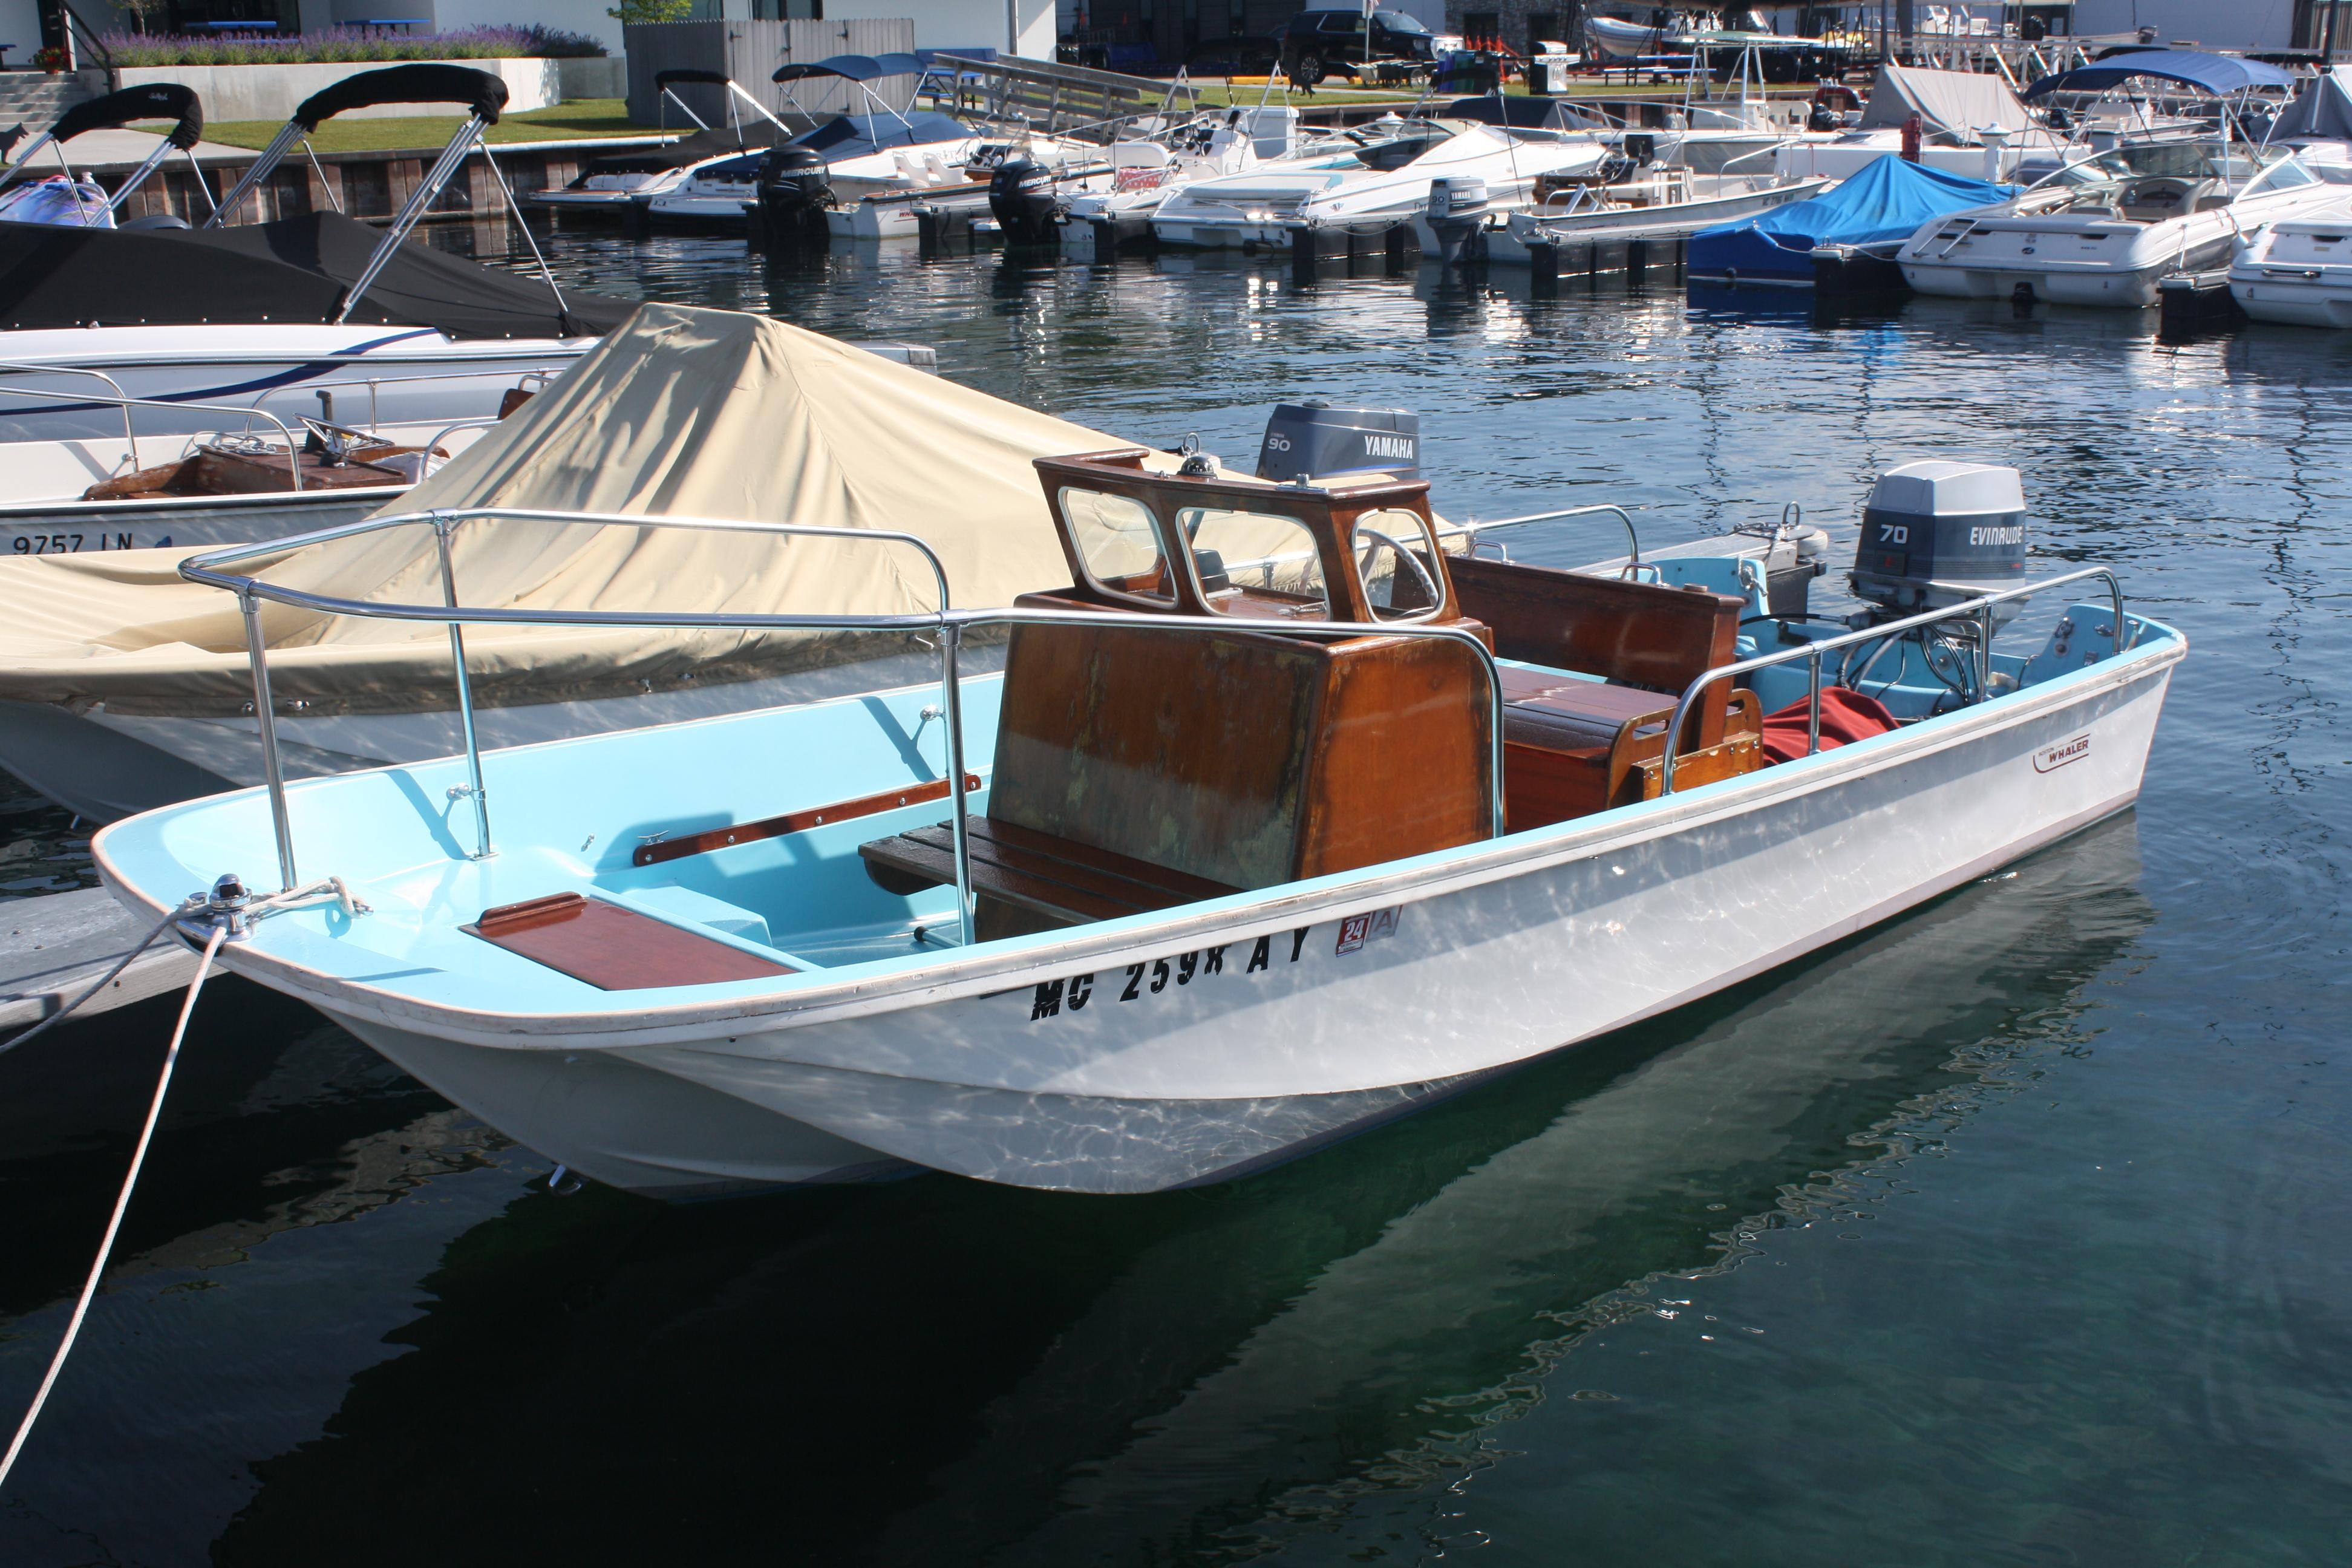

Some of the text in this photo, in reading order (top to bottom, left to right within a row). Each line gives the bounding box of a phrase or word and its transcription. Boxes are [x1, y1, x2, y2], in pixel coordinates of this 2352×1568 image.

[780, 166, 826, 177] MERCURY
[1019, 175, 1052, 188] MERCURY
[1268, 438, 1291, 451] 90
[1365, 436, 1413, 459] YAMAHA
[1880, 524, 1908, 544] 70
[1970, 526, 2022, 544] EVINRUDE
[13, 534, 83, 555] 9757
[2050, 739, 2089, 763] WHALER
[1344, 918, 1364, 942] 24
[1030, 973, 1094, 1021] MC
